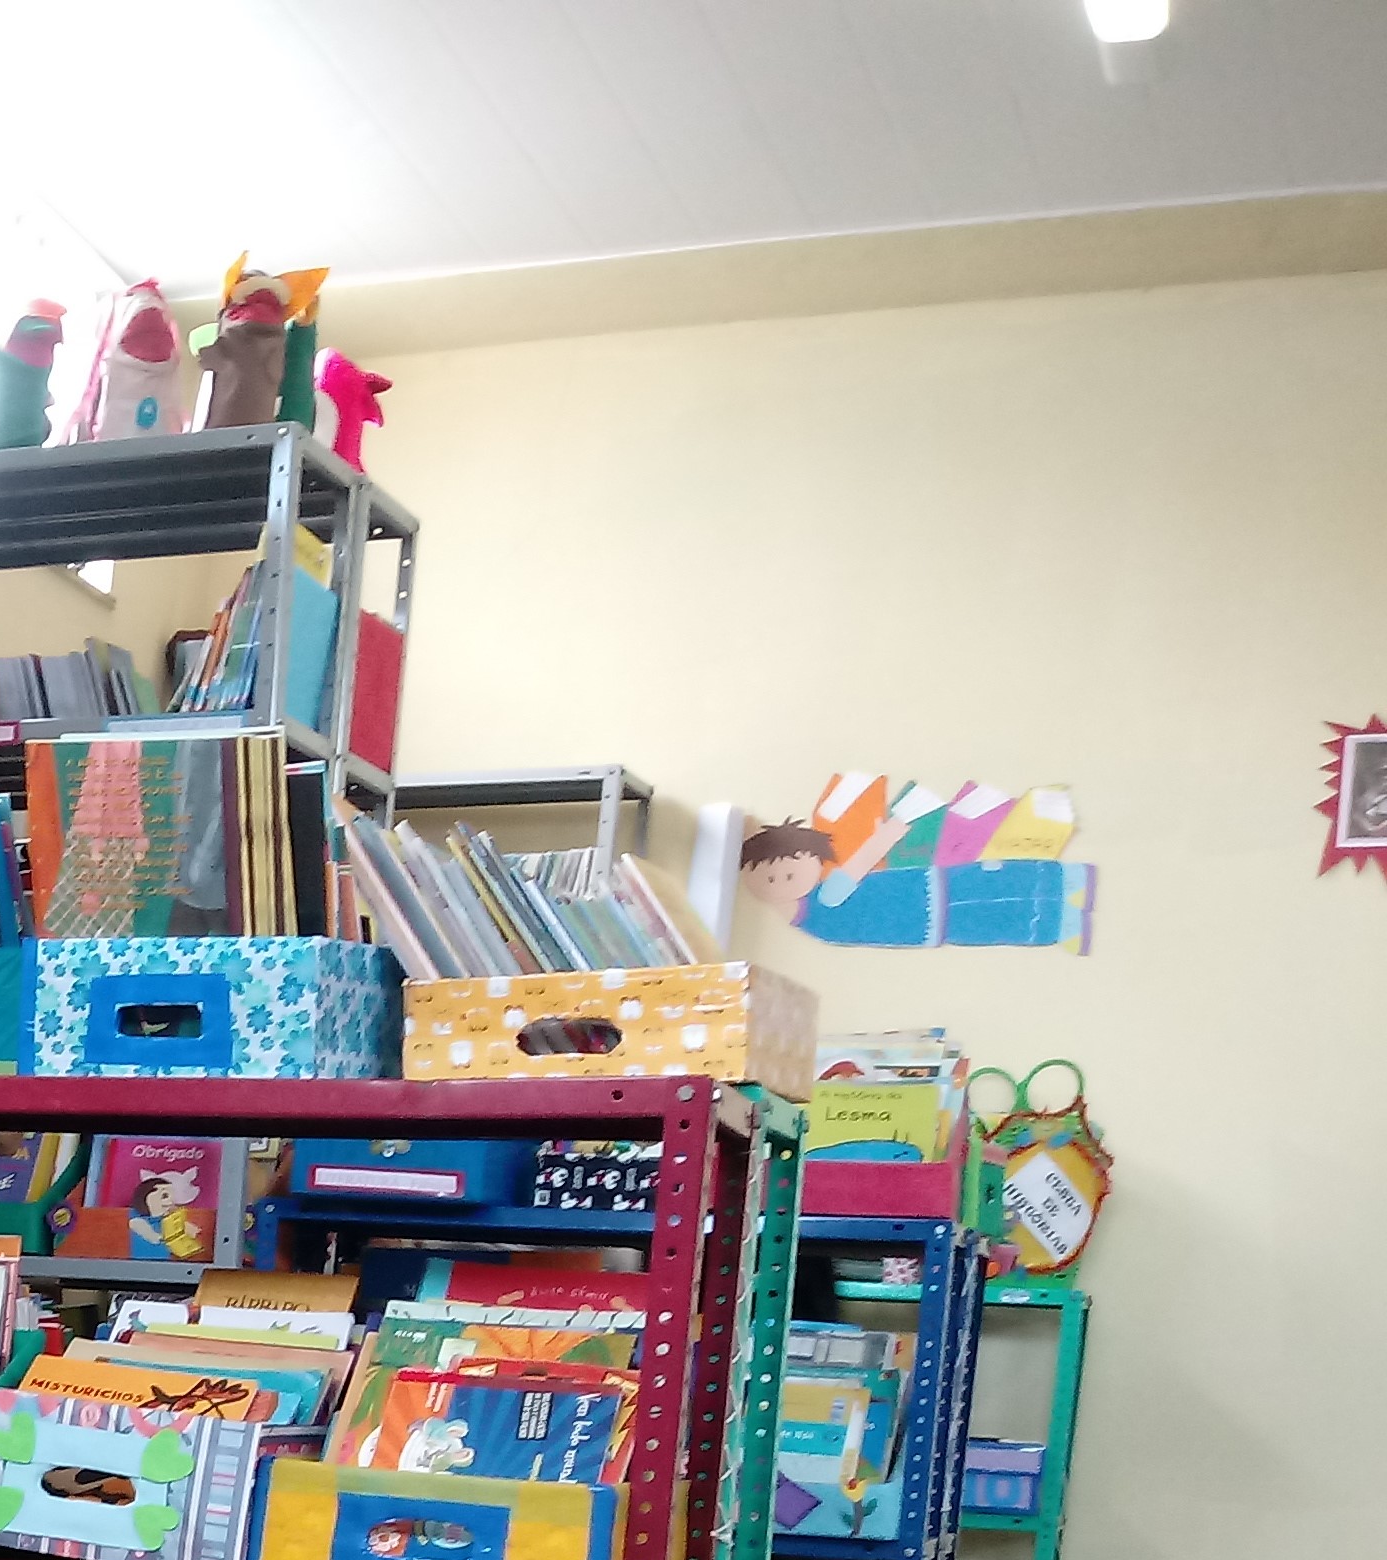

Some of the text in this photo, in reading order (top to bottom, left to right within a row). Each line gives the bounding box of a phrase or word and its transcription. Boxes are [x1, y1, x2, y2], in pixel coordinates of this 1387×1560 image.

[824, 1105, 892, 1122] Lesma
[131, 1143, 206, 1163] Obrigado
[28, 1377, 146, 1404] MISTURICHOS
